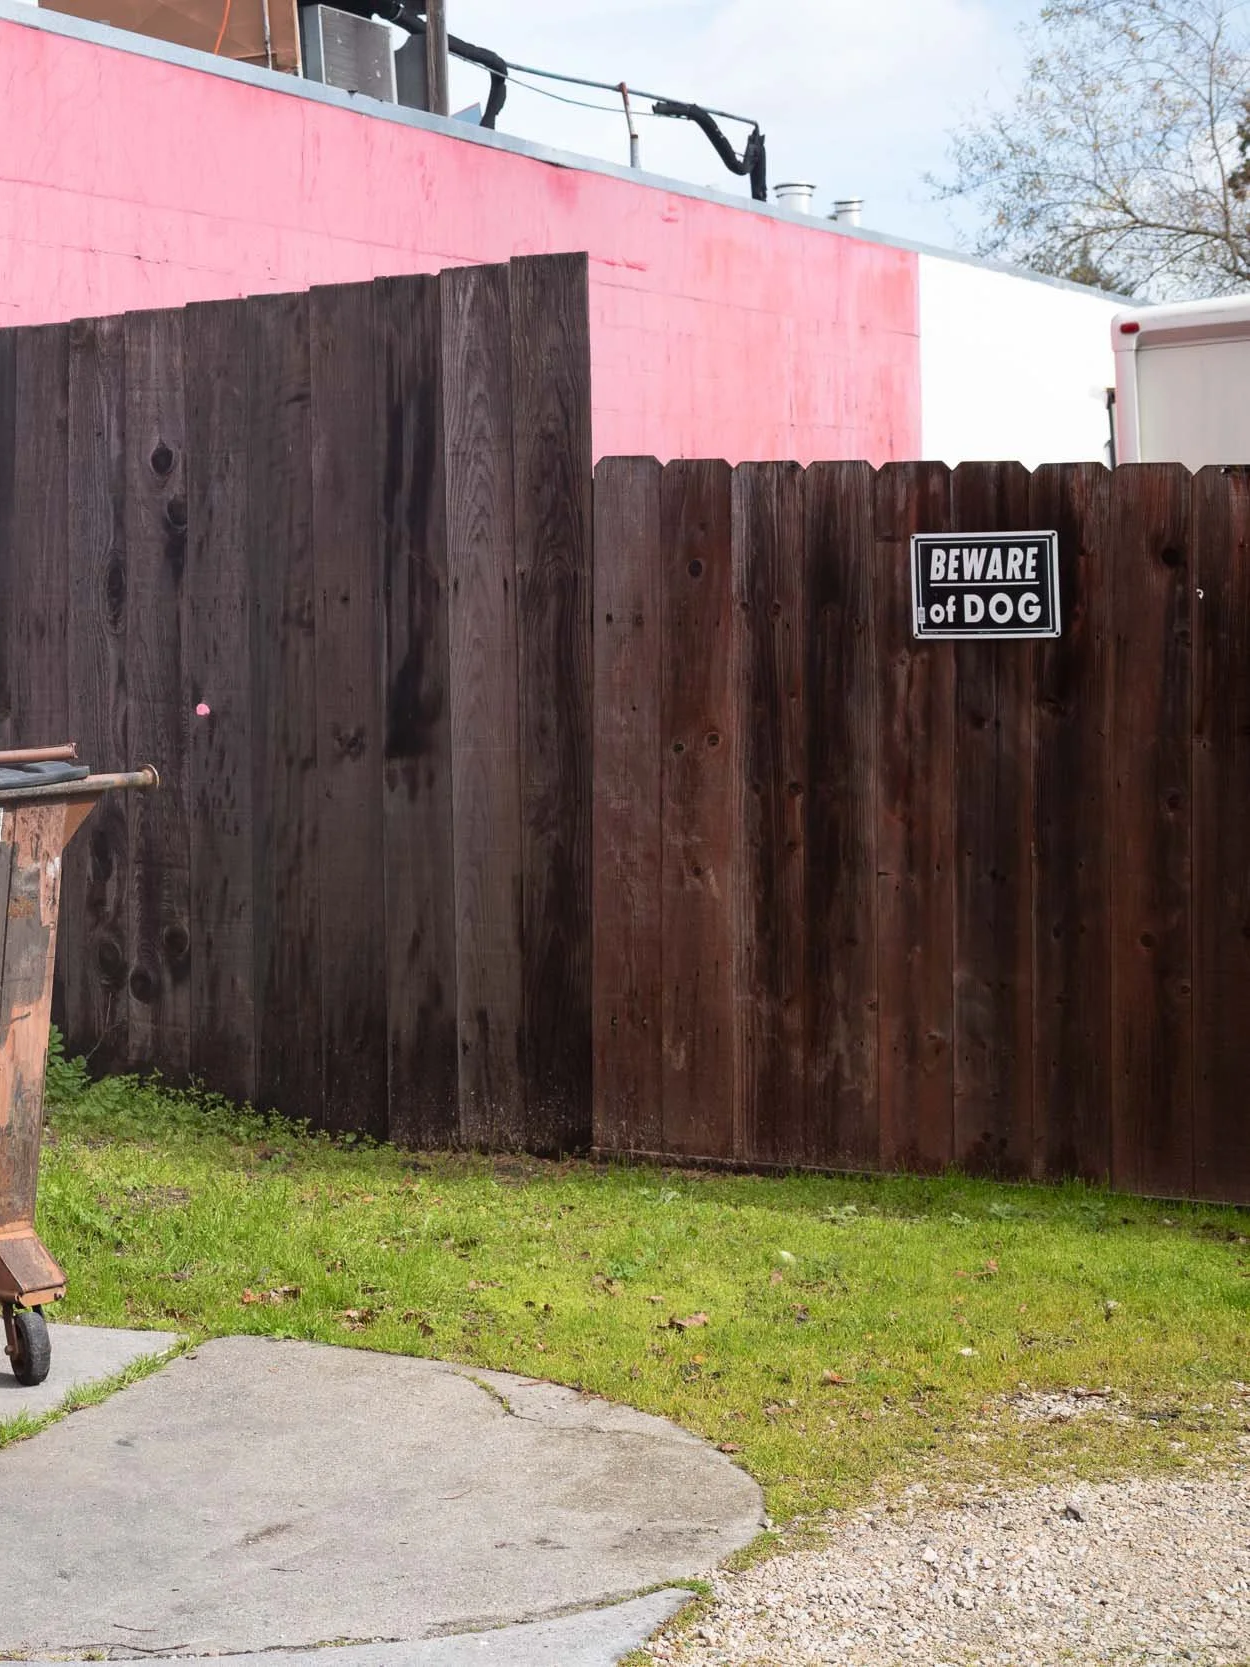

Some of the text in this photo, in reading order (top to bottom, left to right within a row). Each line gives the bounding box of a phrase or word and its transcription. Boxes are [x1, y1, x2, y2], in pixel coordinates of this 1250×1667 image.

[929, 547, 1039, 581] BEWARE
[929, 592, 1042, 624] of DOG
